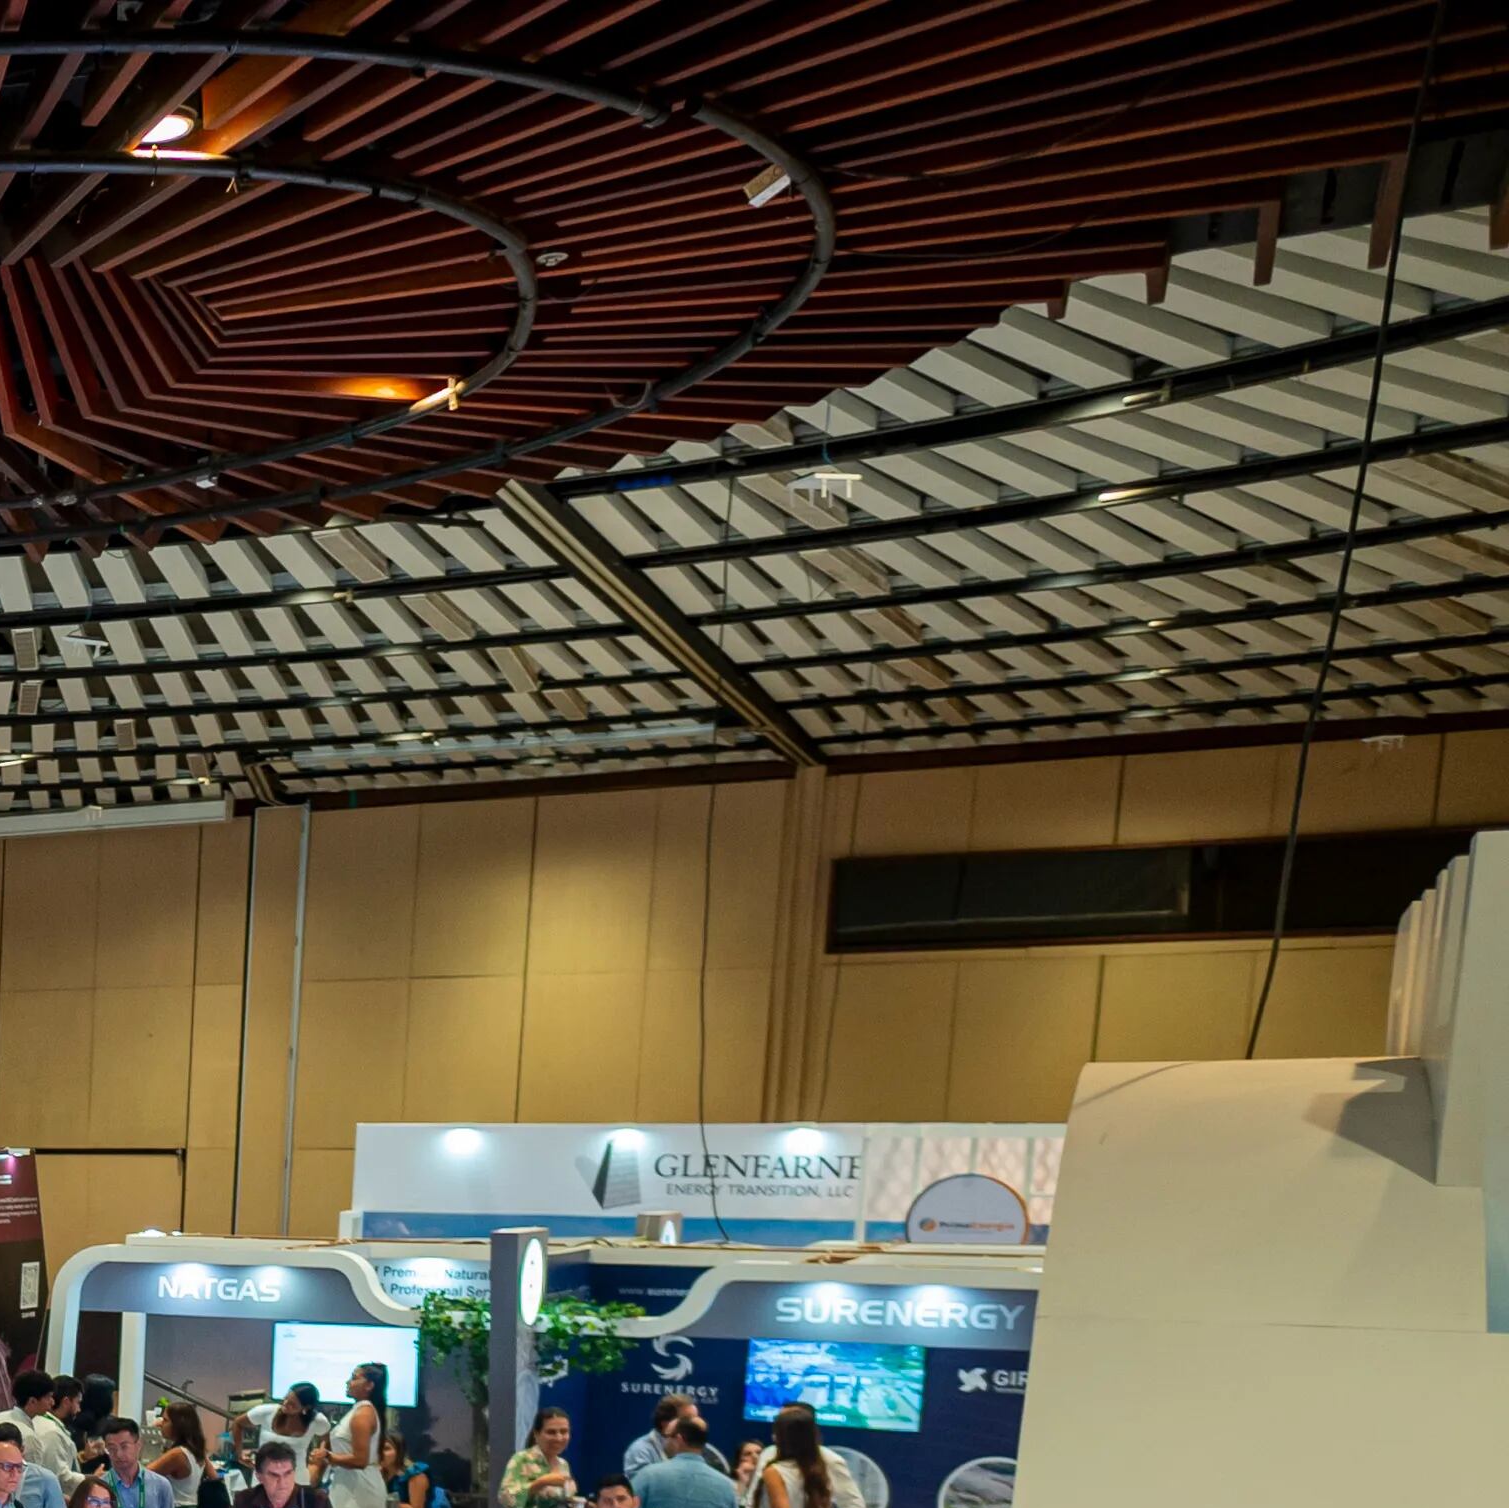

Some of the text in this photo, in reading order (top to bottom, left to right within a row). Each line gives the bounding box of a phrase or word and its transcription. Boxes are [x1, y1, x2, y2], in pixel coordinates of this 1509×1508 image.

[654, 1152, 862, 1180] GLENFARNE
[666, 1183, 721, 1197] ENERGY
[827, 1185, 855, 1198] LLC
[157, 1275, 282, 1303] NATGAS
[775, 1295, 1026, 1331] SURENERGY
[620, 1381, 719, 1398] SURENERGY
